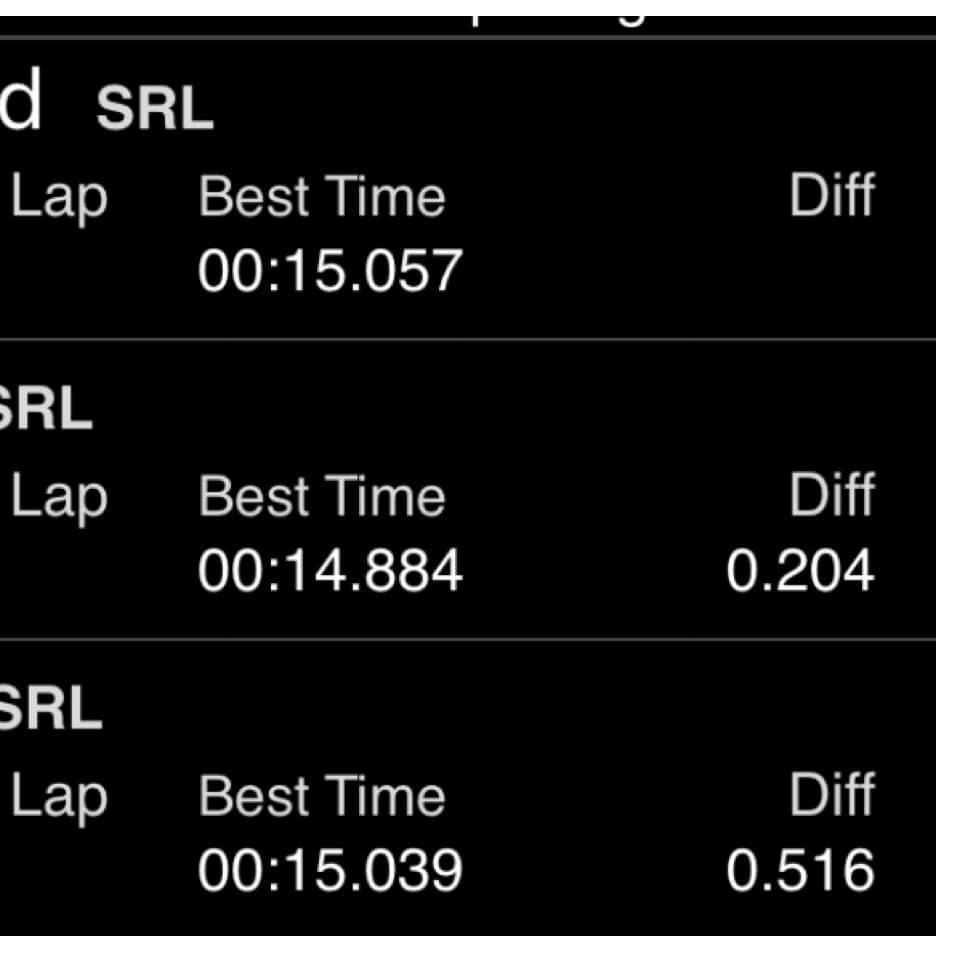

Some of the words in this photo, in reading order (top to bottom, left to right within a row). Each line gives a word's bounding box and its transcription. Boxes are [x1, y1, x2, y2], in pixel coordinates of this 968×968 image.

[97, 84, 214, 130] SRL
[13, 172, 107, 229] Lap
[201, 175, 309, 217] Best
[325, 175, 445, 217] Time
[792, 171, 876, 216] Diff
[199, 248, 463, 292] 00:15.057
[13, 472, 107, 529] Lap
[201, 475, 309, 517] Best
[325, 475, 445, 517] Time
[792, 471, 876, 516] Diff
[199, 548, 463, 592] 00:14.884
[728, 548, 875, 592] 0.204
[13, 772, 107, 829] Lap
[201, 775, 309, 817] Best
[325, 775, 445, 817] Time
[792, 771, 876, 816] Diff
[199, 848, 463, 892] 00:15.039
[728, 848, 875, 892] 0.516
